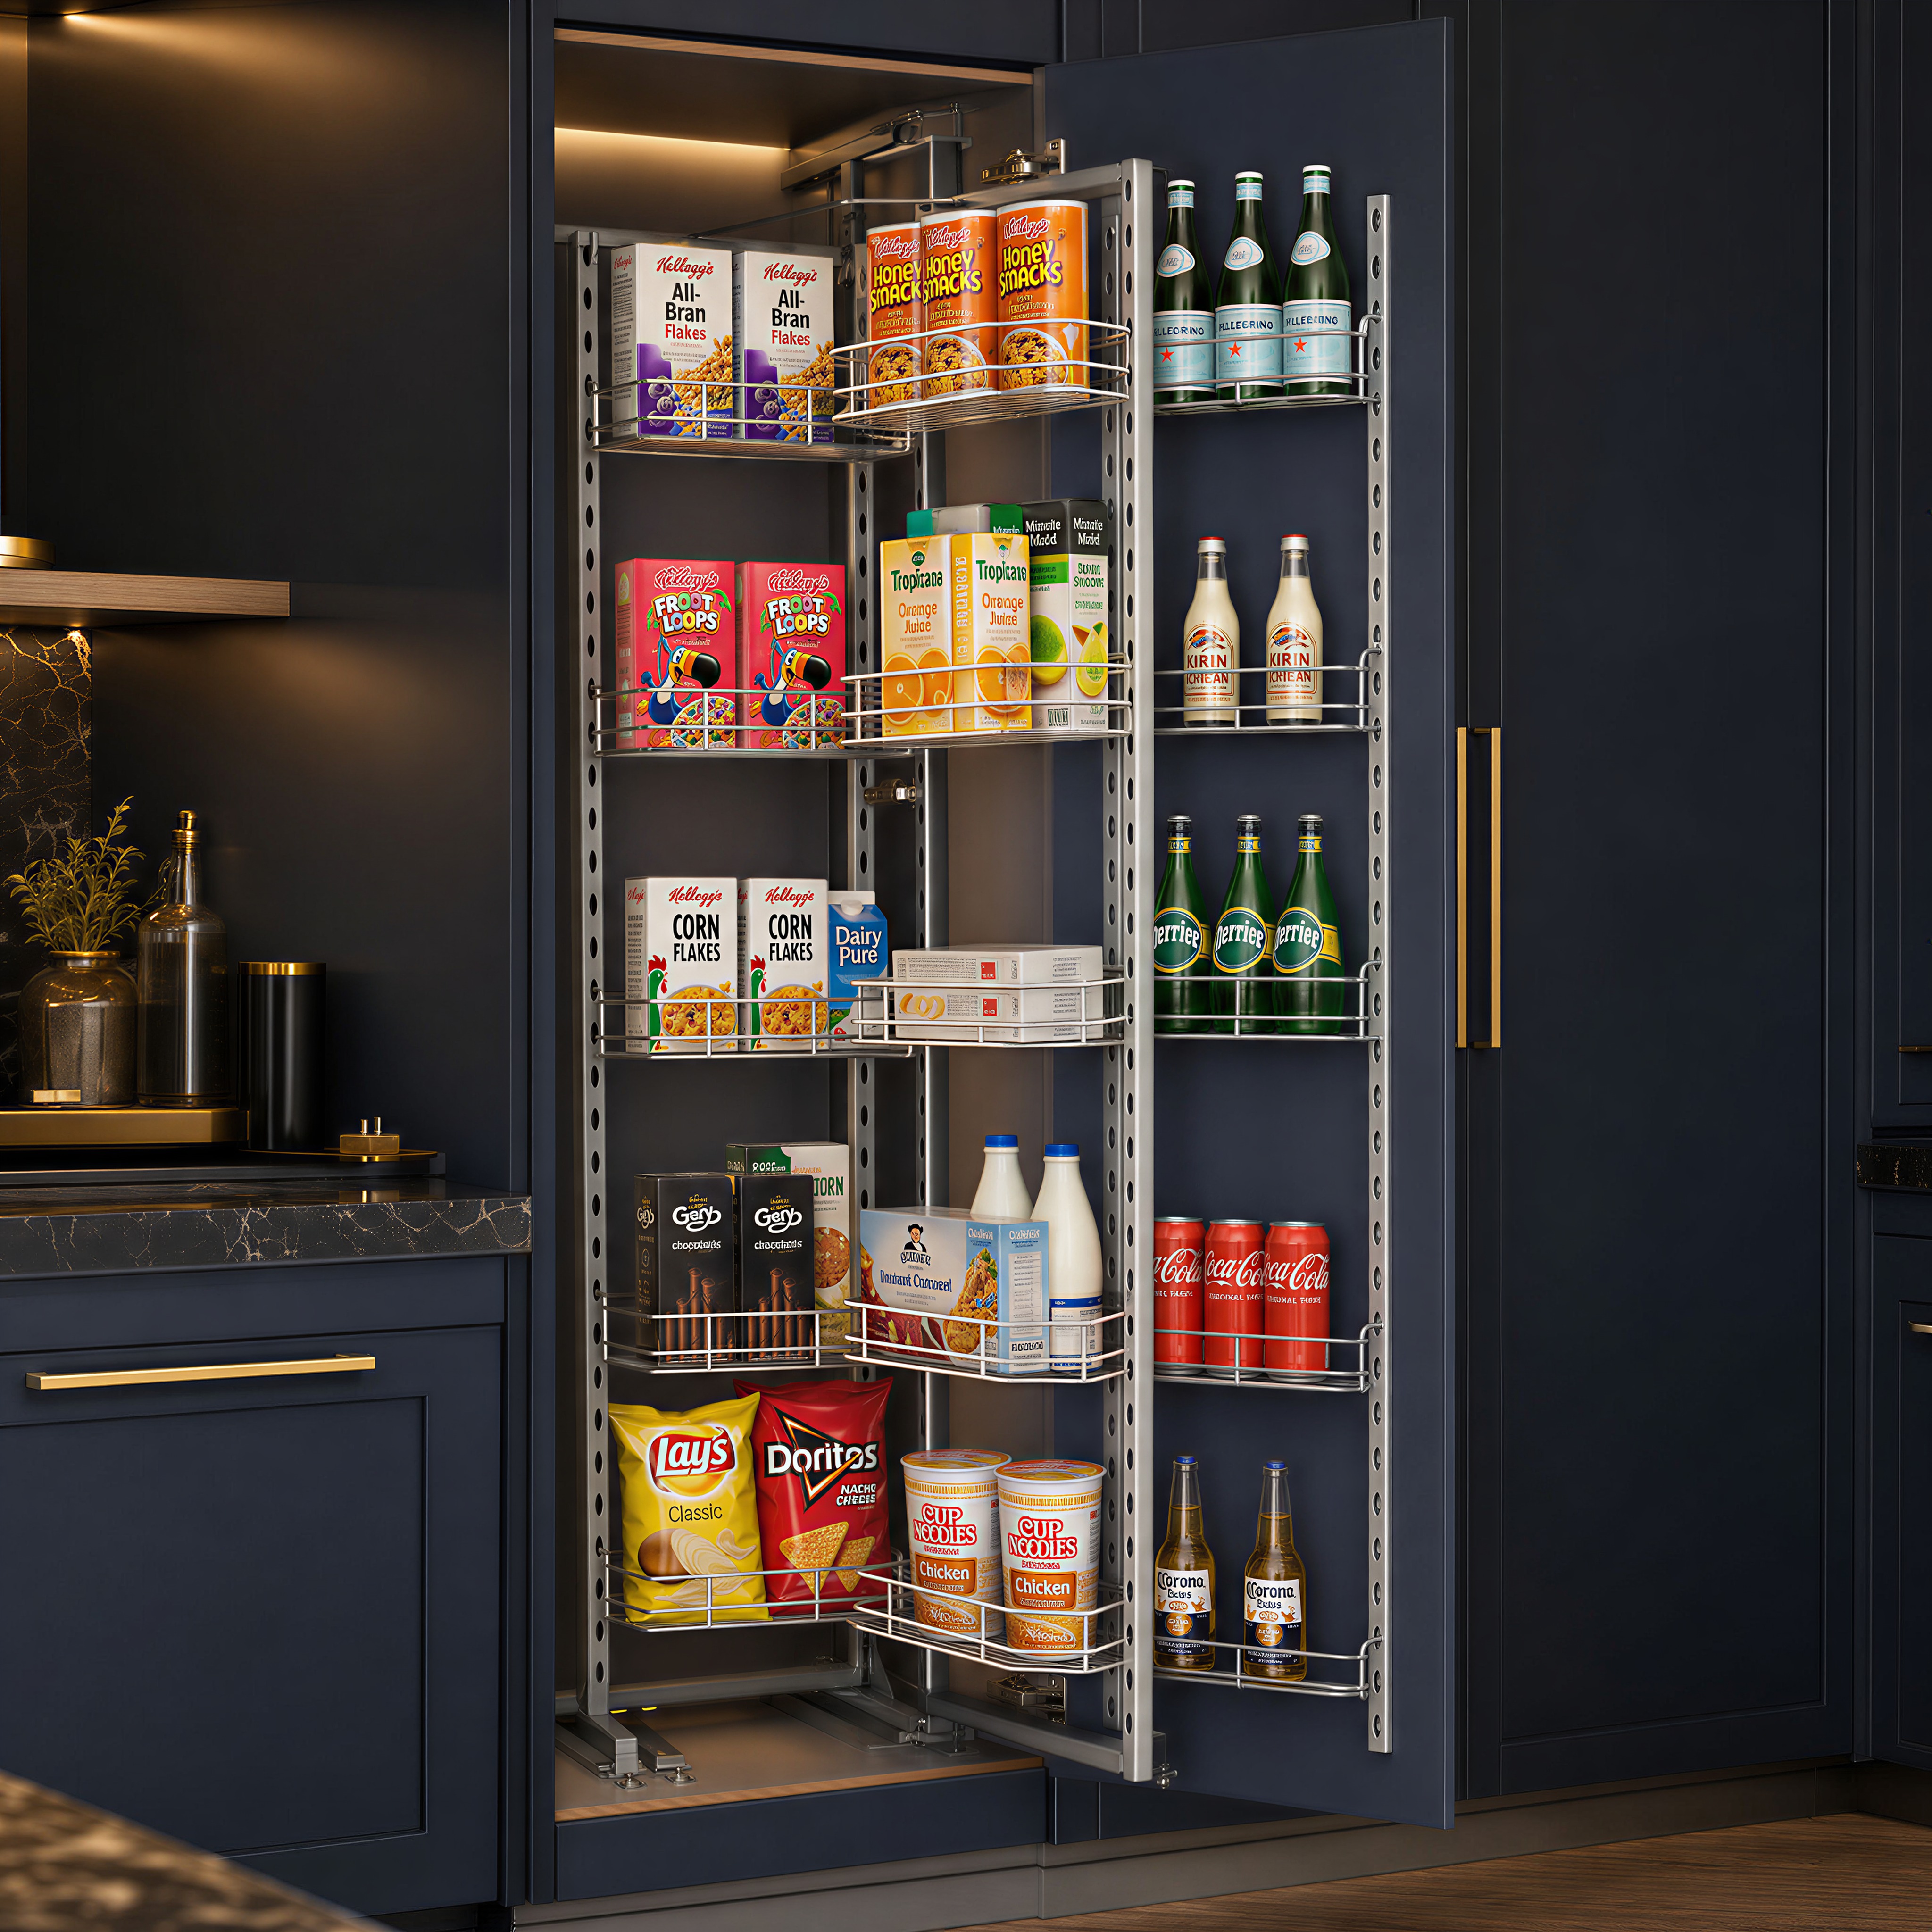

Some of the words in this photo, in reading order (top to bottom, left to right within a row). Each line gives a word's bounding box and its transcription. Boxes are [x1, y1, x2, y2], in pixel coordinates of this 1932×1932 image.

[672, 282, 701, 302] All-
[778, 289, 805, 309] All-
[665, 301, 706, 323] Bran
[772, 308, 810, 329] Bran
[665, 323, 707, 341] Flakes
[772, 329, 811, 346] Flakes
[654, 592, 714, 618] FROOT
[767, 596, 824, 620] FROOT
[662, 611, 718, 633] LOOPS
[775, 614, 829, 635] LOOPS
[1187, 654, 1227, 669] KIRIN
[1269, 652, 1309, 667] KIRIN
[673, 913, 720, 940] CORN
[768, 913, 813, 940] CORN
[835, 925, 882, 949] Dairy
[673, 942, 721, 962] FLAKES
[769, 942, 813, 962] FLAKES
[839, 946, 879, 967] Pure
[655, 1435, 729, 1477] Lay's
[767, 1442, 878, 1474] Doritos
[841, 1483, 876, 1494] NACHO
[668, 1503, 723, 1523] Classic
[923, 1505, 961, 1525] CUP
[1019, 1516, 1062, 1539] CUP
[919, 1561, 970, 1580] Chicken
[1015, 1577, 1070, 1596] Chicken
